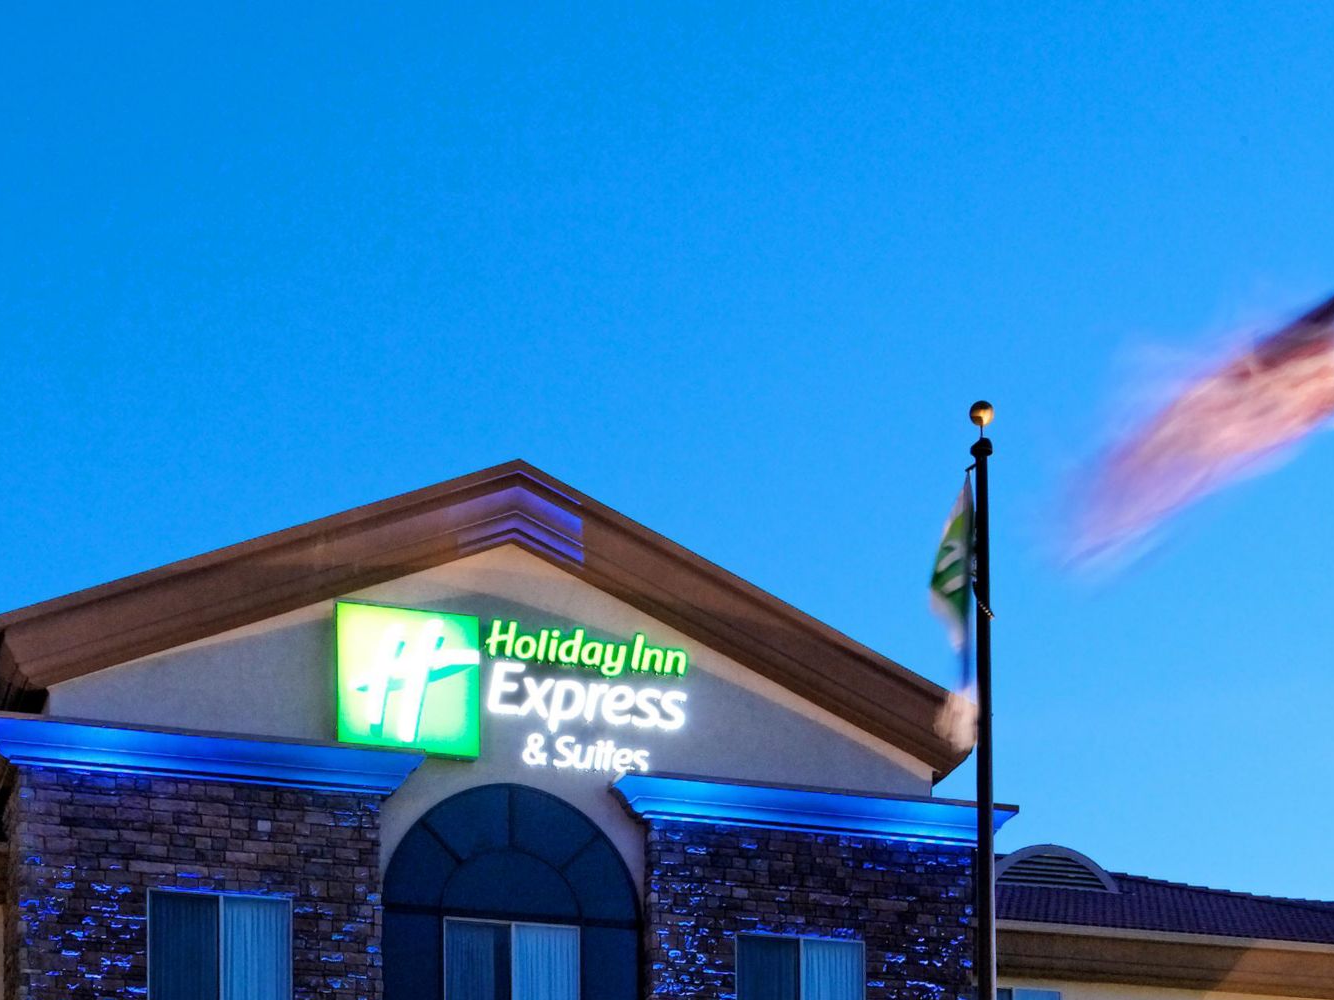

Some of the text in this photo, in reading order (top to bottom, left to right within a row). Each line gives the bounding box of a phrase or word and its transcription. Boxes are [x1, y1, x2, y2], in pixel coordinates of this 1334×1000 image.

[486, 620, 687, 677] Holiday Inn
[486, 661, 688, 733] Express
[521, 732, 650, 772] & Suites
